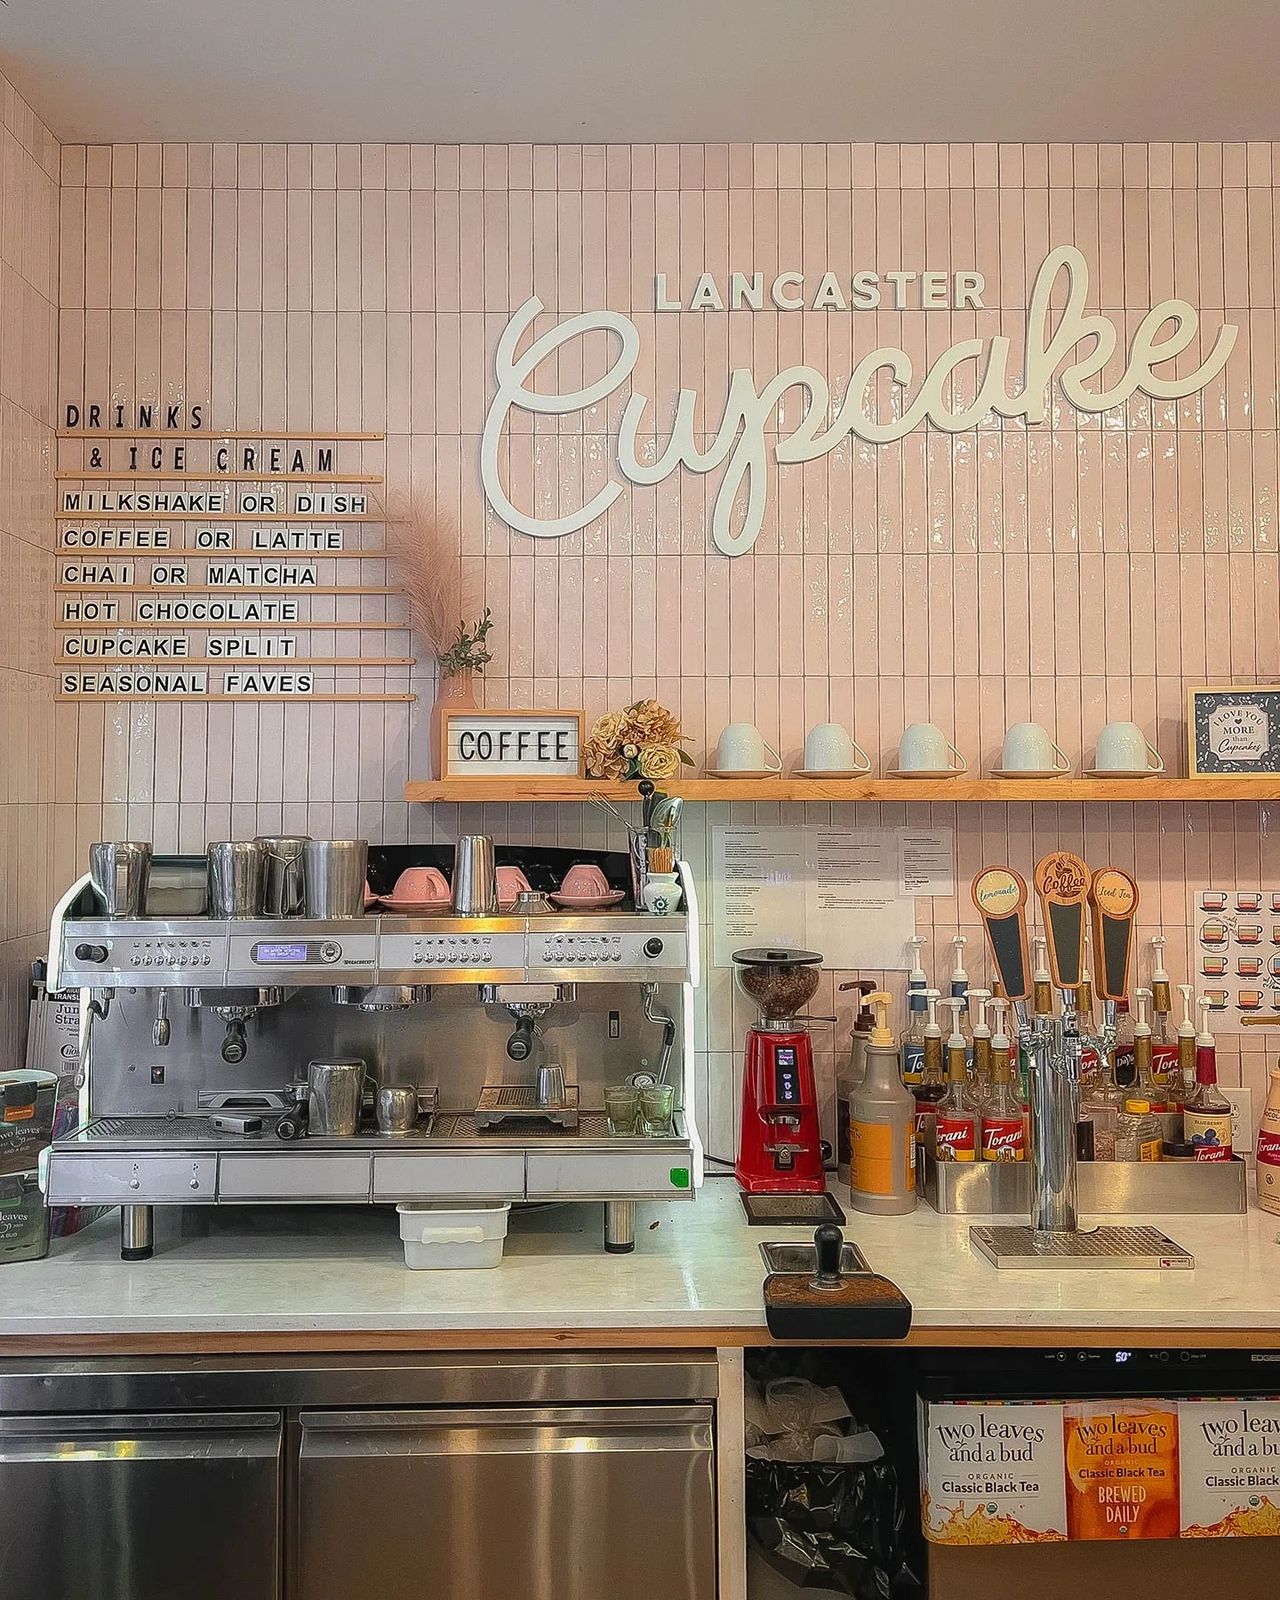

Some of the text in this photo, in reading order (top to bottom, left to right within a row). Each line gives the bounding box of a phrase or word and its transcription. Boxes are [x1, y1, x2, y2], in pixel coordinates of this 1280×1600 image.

[656, 271, 986, 312] LANCASTER
[480, 245, 1239, 558] Cupcake
[66, 405, 203, 429] DRINKS
[90, 446, 333, 473] & ICE CREAM
[65, 493, 366, 514] MILKSHAKE OR DISH
[64, 530, 342, 550] COFFEE OR LATTE
[64, 566, 316, 585] CHAI OR MATCHA
[65, 602, 296, 620] HOT CHOCOLATE
[65, 638, 294, 657] CUPCAKE SPLIT
[64, 675, 312, 693] SEASONAL FAVES
[1217, 710, 1243, 723] LOVE
[1245, 711, 1264, 726] YOU
[1223, 726, 1255, 735] MORE
[460, 731, 569, 761] COFFEE
[1218, 738, 1263, 754] Cupcakes
[1043, 875, 1086, 895] Coffee
[1099, 886, 1132, 899] Iced Tea
[985, 1125, 1024, 1150] Torani
[936, 1413, 1045, 1450] two leaves
[1077, 1413, 1167, 1446] two leaves
[1200, 1418, 1239, 1446] two
[949, 1441, 1034, 1462] and a bud
[1086, 1437, 1158, 1456] and a bud
[1212, 1436, 1246, 1457] and
[1248, 1443, 1260, 1456] a
[968, 1472, 1014, 1480] ORGANIC
[1079, 1467, 1165, 1479] Classic Black Tea
[1231, 1466, 1276, 1474] ORGANIC
[942, 1481, 1040, 1493] Classic Black Tea
[1205, 1474, 1280, 1487] Classic Black
[1098, 1485, 1147, 1504] BREWED
[1106, 1505, 1140, 1523] DAILY
